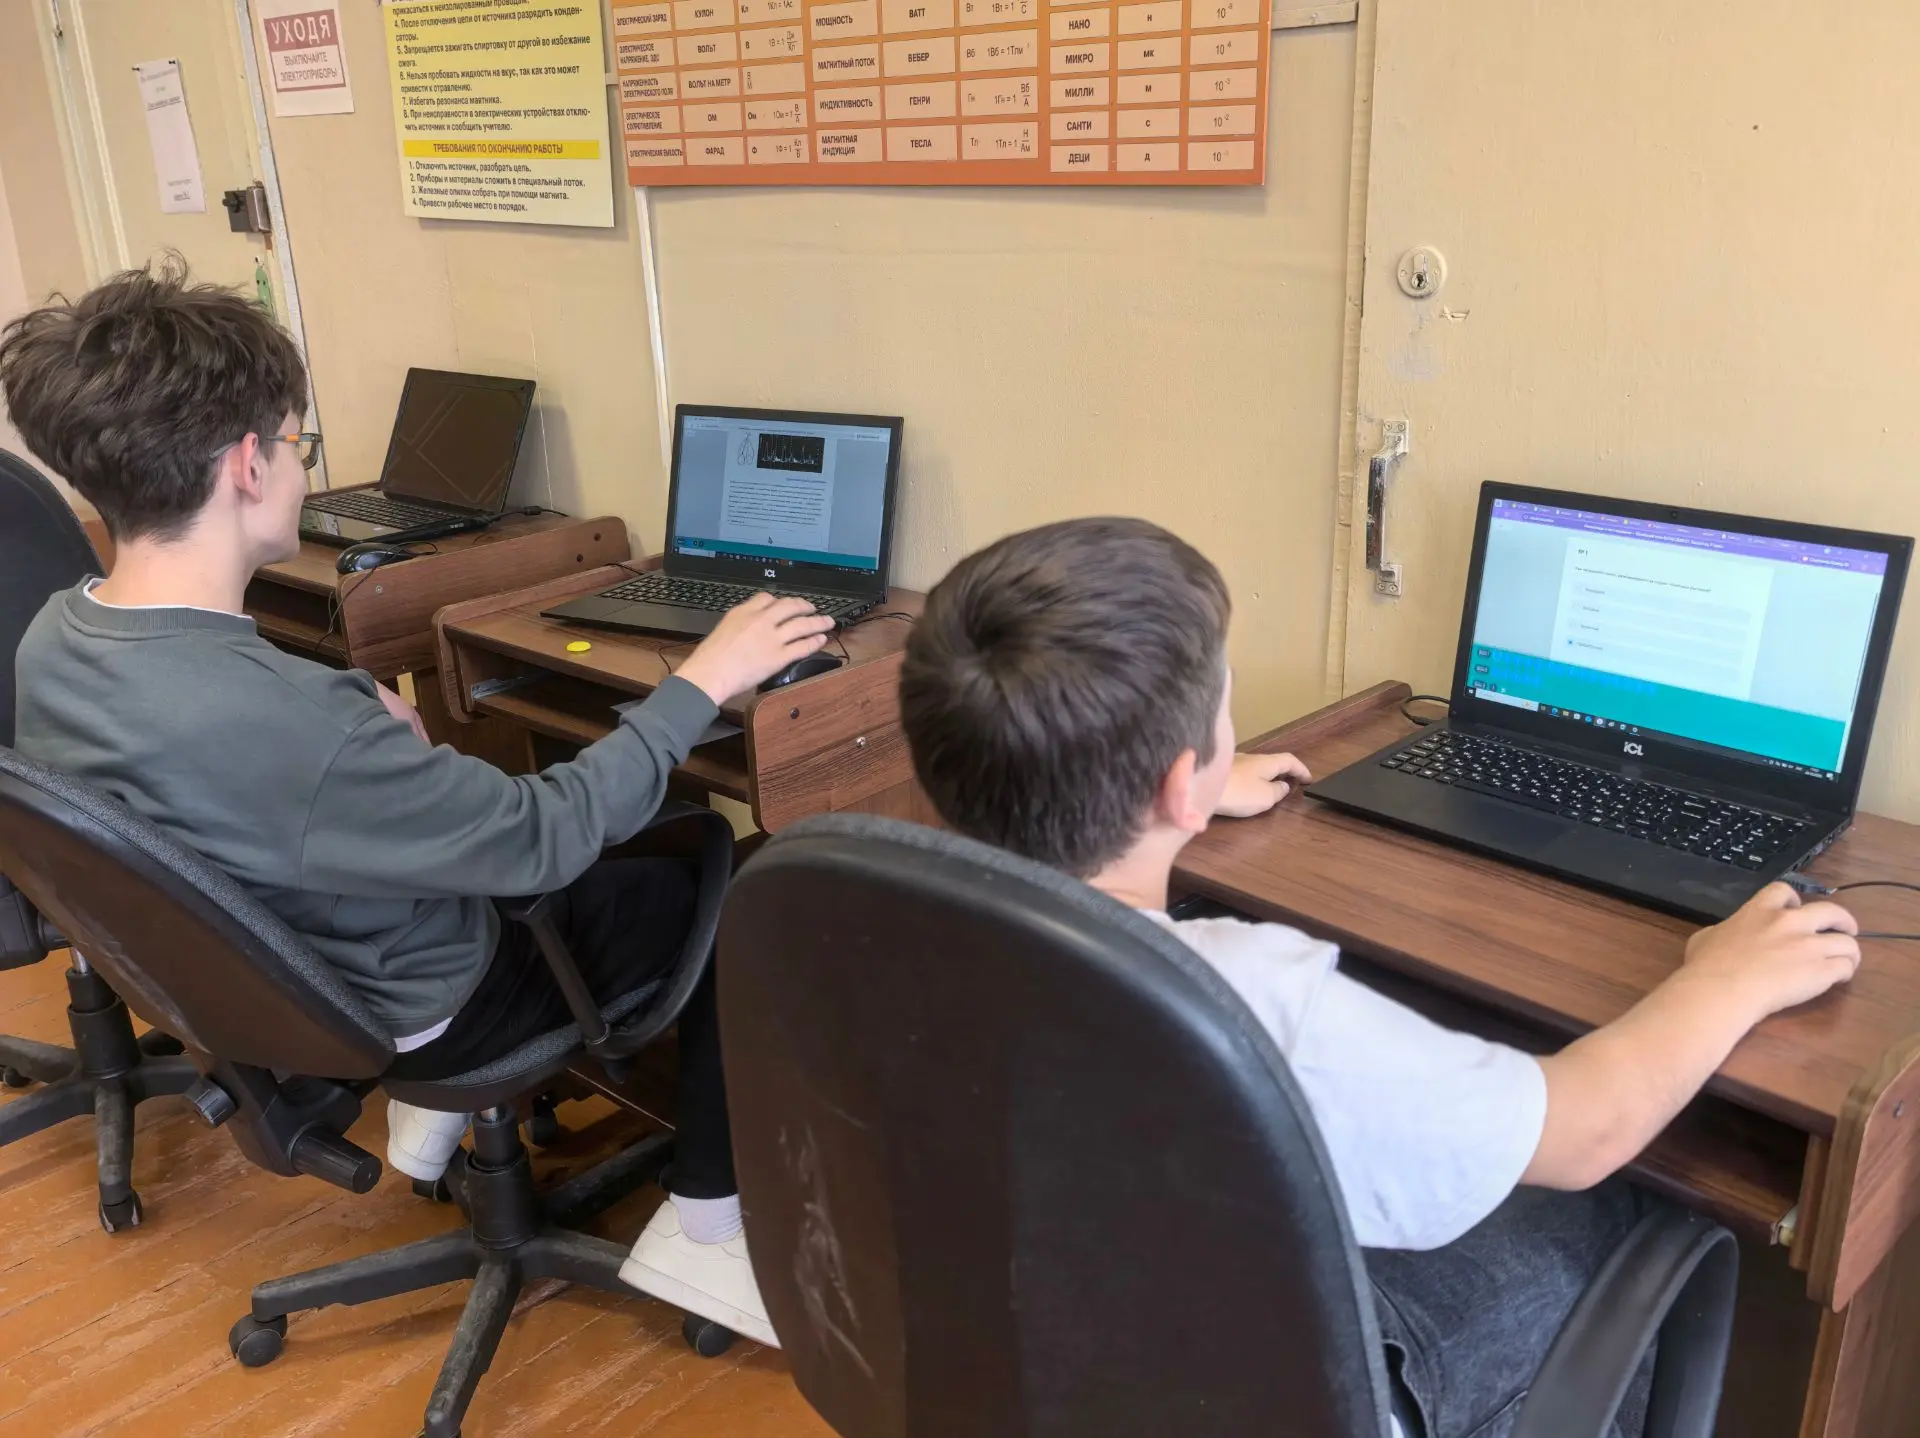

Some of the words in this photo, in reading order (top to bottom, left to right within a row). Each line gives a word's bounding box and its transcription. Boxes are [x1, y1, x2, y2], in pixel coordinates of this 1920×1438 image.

[394, 19, 400, 28] 4.
[400, 18, 420, 28] После
[420, 16, 457, 26] отключения
[457, 15, 473, 24] цепи
[482, 12, 516, 22] источника
[517, 9, 553, 22] разрядить
[554, 7, 582, 17] конден-
[695, 9, 714, 18] КУЛОН
[909, 8, 925, 18] ВАТТ
[816, 15, 853, 27] МОЩНОСТЬ
[1069, 19, 1090, 30] НАНО
[271, 15, 331, 45] УХОДЯ
[397, 45, 403, 55] 5.
[404, 44, 444, 56] Запрещается
[445, 43, 473, 52] зажигать
[474, 41, 507, 51] спиртовку
[517, 36, 541, 50] другой
[542, 38, 550, 46] во
[551, 35, 591, 45] избежание
[697, 45, 716, 53] ВОЛЬТ
[908, 52, 929, 62] ВЕБЕР
[1065, 53, 1094, 64] МИКРО
[818, 58, 854, 70] МАГНИТНЫЙ
[855, 57, 875, 67] ПОТОК
[280, 67, 337, 82] ЭЛЕКТРОПРИБОРЫ
[400, 71, 406, 80] 6.
[406, 71, 427, 80] Нельзя
[428, 69, 460, 80] пробовать
[460, 69, 491, 78] жидкости
[501, 69, 519, 79] вкус,
[519, 68, 531, 76] так
[531, 67, 543, 75] как
[557, 65, 580, 74] может
[401, 85, 428, 94] привести
[433, 84, 472, 93] отравлению.
[689, 80, 707, 89] ВОЛЬТ
[707, 79, 716, 87] НА
[716, 78, 731, 87] МЕТР
[1065, 87, 1094, 97] МИЛЛИ
[402, 97, 408, 106] 7.
[409, 96, 435, 106] Избегать
[436, 97, 469, 106] резонанса
[470, 96, 502, 104] маятника.
[820, 98, 873, 110] ИНДУКТИВНОСТЬ
[909, 96, 931, 106] ГЕНРИ
[403, 109, 409, 118] 8.
[410, 109, 422, 120] При
[422, 111, 468, 120] неисправности
[474, 110, 521, 119] электрических
[523, 107, 564, 119] устройствах
[566, 108, 591, 116] отклю-
[708, 114, 717, 122] ОМ
[451, 121, 482, 131] сообщить
[483, 123, 513, 132] учителю.
[1066, 121, 1092, 131] САНТИ
[821, 135, 858, 144] МАГНИТНАЯ
[910, 139, 932, 148] ТЕСЛА
[433, 143, 475, 153] ТРЕБОВАНИЯ
[477, 144, 487, 153] ПО
[488, 143, 532, 154] ОКОНЧАНИЮ
[533, 144, 563, 154] РАБОТЫ
[705, 147, 725, 156] ФАРАД
[752, 146, 757, 154] Ф
[822, 146, 855, 156] ИНДУКЦИЯ
[1068, 153, 1090, 164] ДЕЦИ
[415, 161, 448, 170] Отключить
[448, 163, 479, 172] источник,
[480, 162, 512, 173] разобрать
[513, 164, 532, 173] цепь.
[409, 173, 415, 182] 2.
[416, 173, 443, 183] Приборы
[449, 176, 483, 184] материалы
[484, 177, 512, 185] сложить
[518, 177, 562, 187] специальный
[563, 179, 585, 187] лоток.
[411, 185, 417, 194] 3.
[418, 186, 448, 195] Железные
[449, 188, 471, 196] опилки
[472, 188, 497, 198] собрать
[498, 190, 510, 198] при
[511, 190, 538, 199] помощи
[539, 191, 569, 200] магнита.
[412, 198, 418, 206] 4.
[419, 197, 447, 208] Привести
[447, 199, 473, 209] рабочее
[473, 202, 493, 210] место
[498, 203, 528, 212] порядок.
